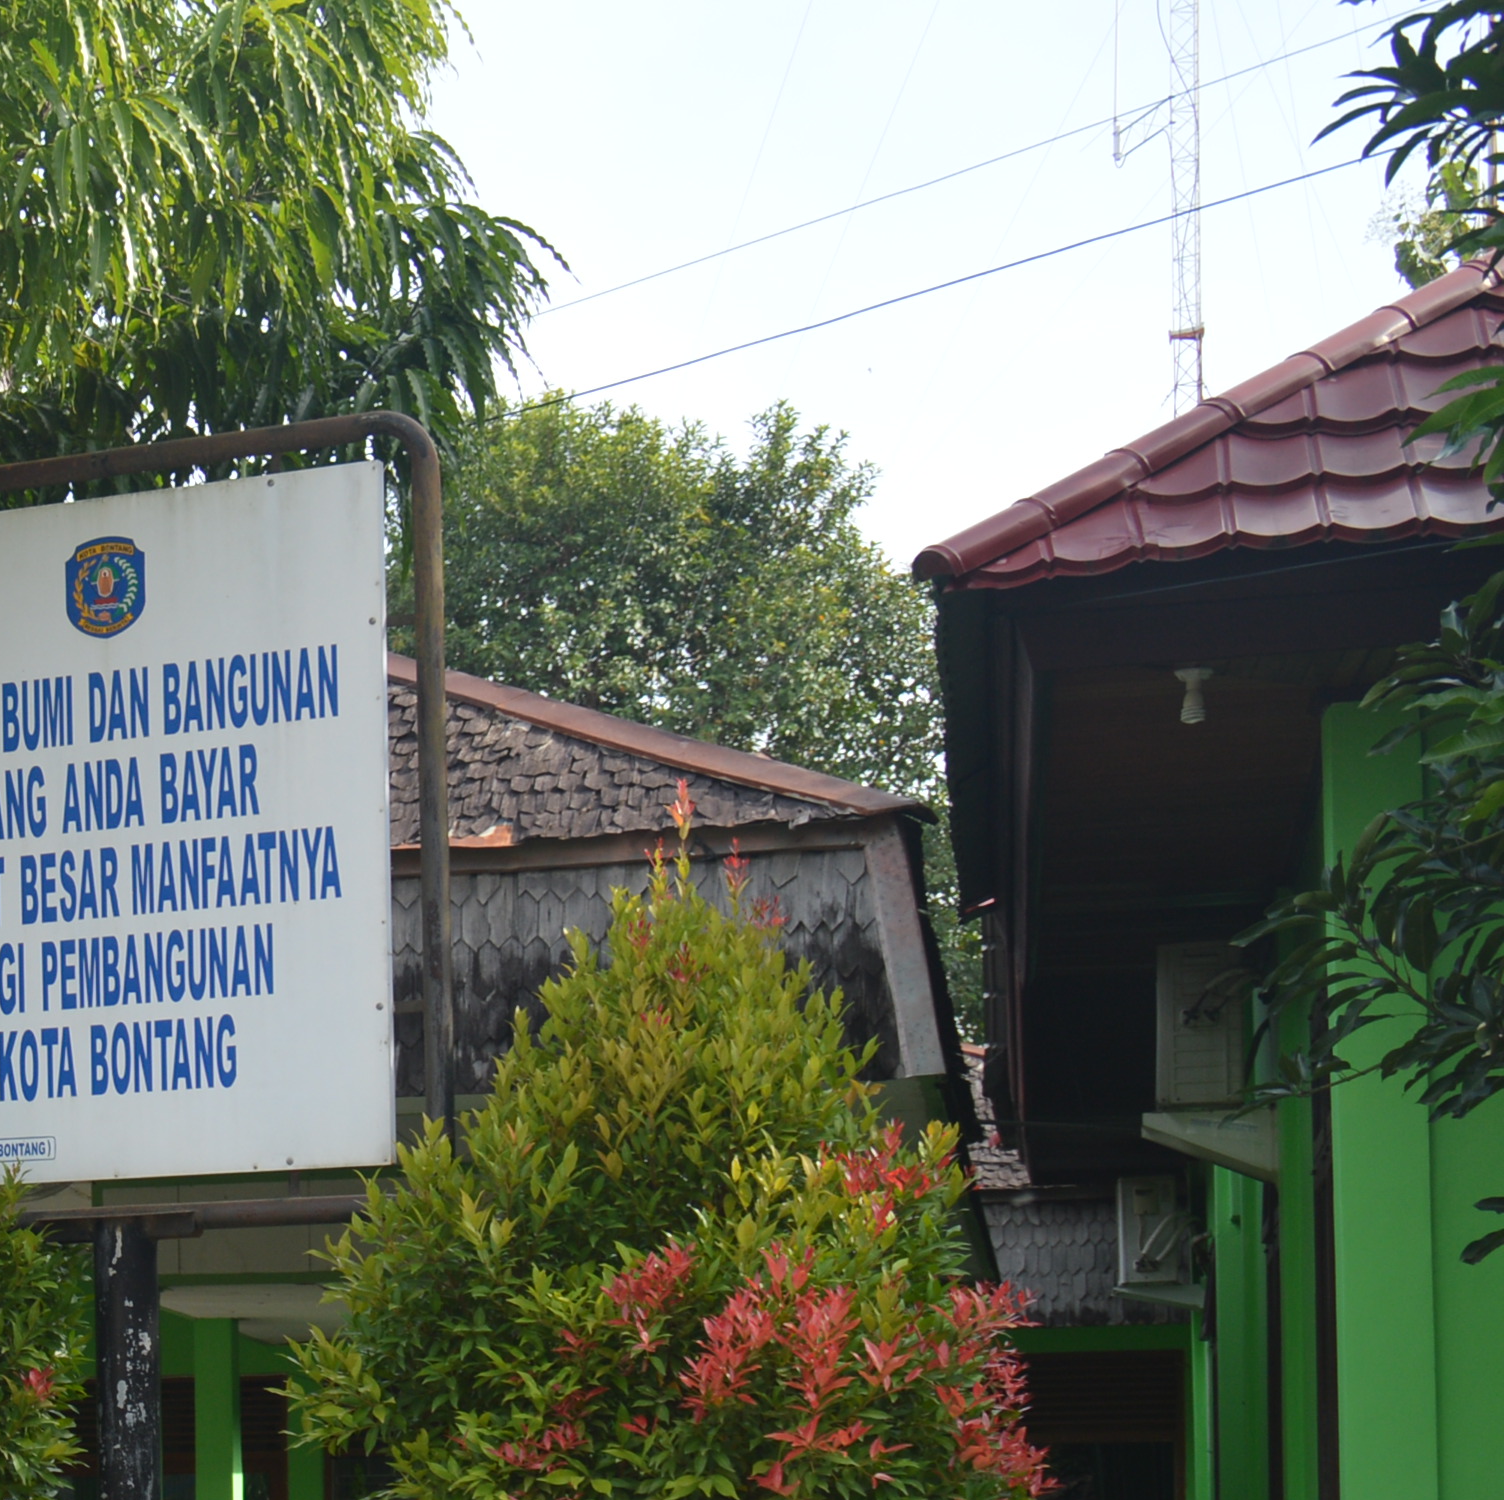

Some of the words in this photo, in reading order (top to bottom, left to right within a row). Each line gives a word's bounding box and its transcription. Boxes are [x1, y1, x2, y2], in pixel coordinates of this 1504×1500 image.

[1, 675, 74, 753] BUMI
[87, 666, 150, 744] DAN
[162, 643, 339, 736] BANGUNAN
[62, 756, 145, 834] ANDA
[159, 743, 260, 825] BAYAR
[20, 846, 121, 926] BESAR
[130, 825, 342, 916] MANFAATNYA
[41, 922, 274, 1012] PEMBANGUNAN
[90, 1013, 237, 1096] BONTANG
